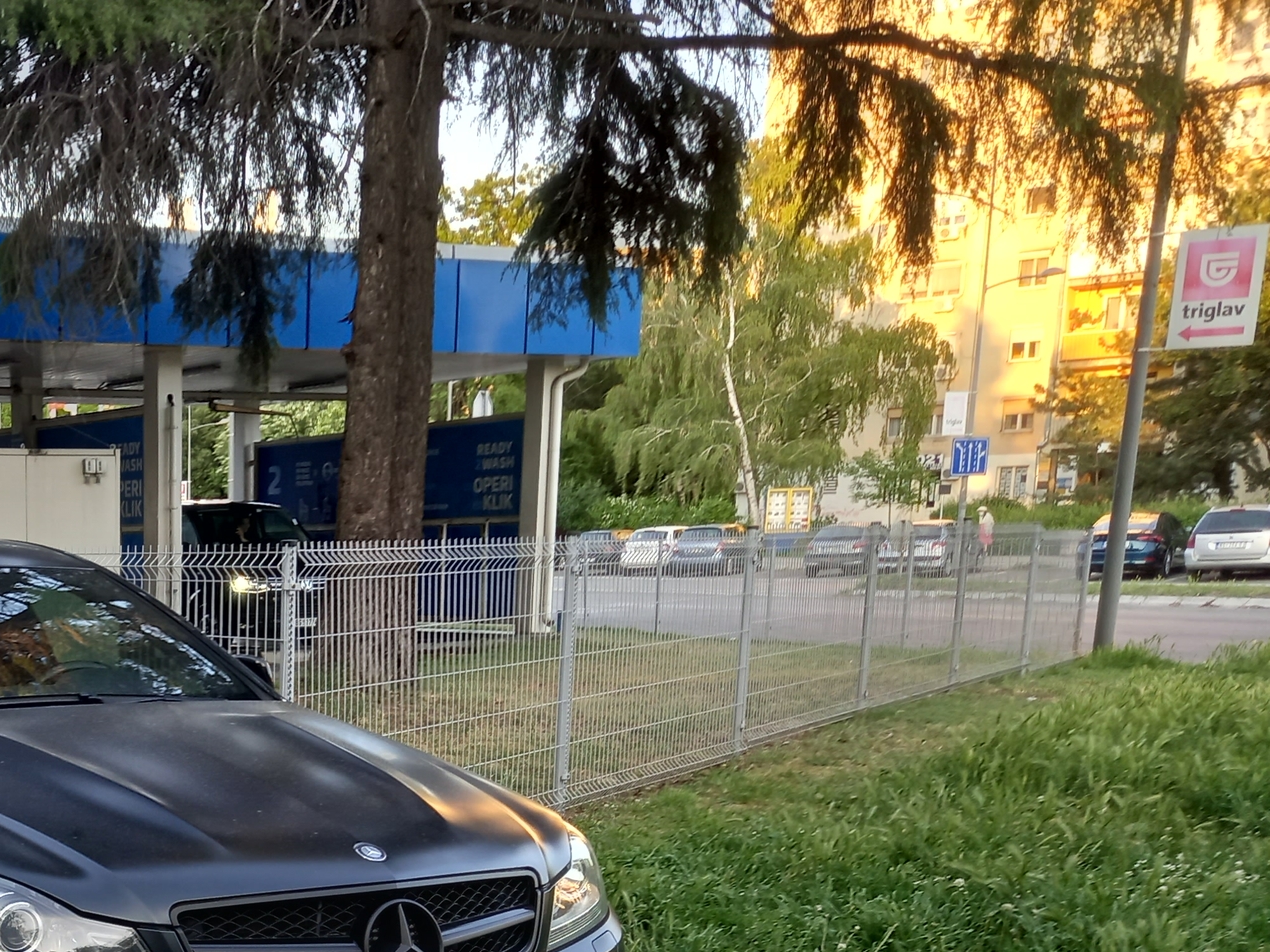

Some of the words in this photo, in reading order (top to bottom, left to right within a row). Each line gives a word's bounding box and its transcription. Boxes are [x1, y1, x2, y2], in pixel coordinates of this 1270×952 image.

[1181, 301, 1246, 323] triglav
[476, 441, 513, 456] READY
[267, 466, 281, 495] 2
[473, 475, 514, 494] OPERI
[482, 493, 514, 511] KLIK
